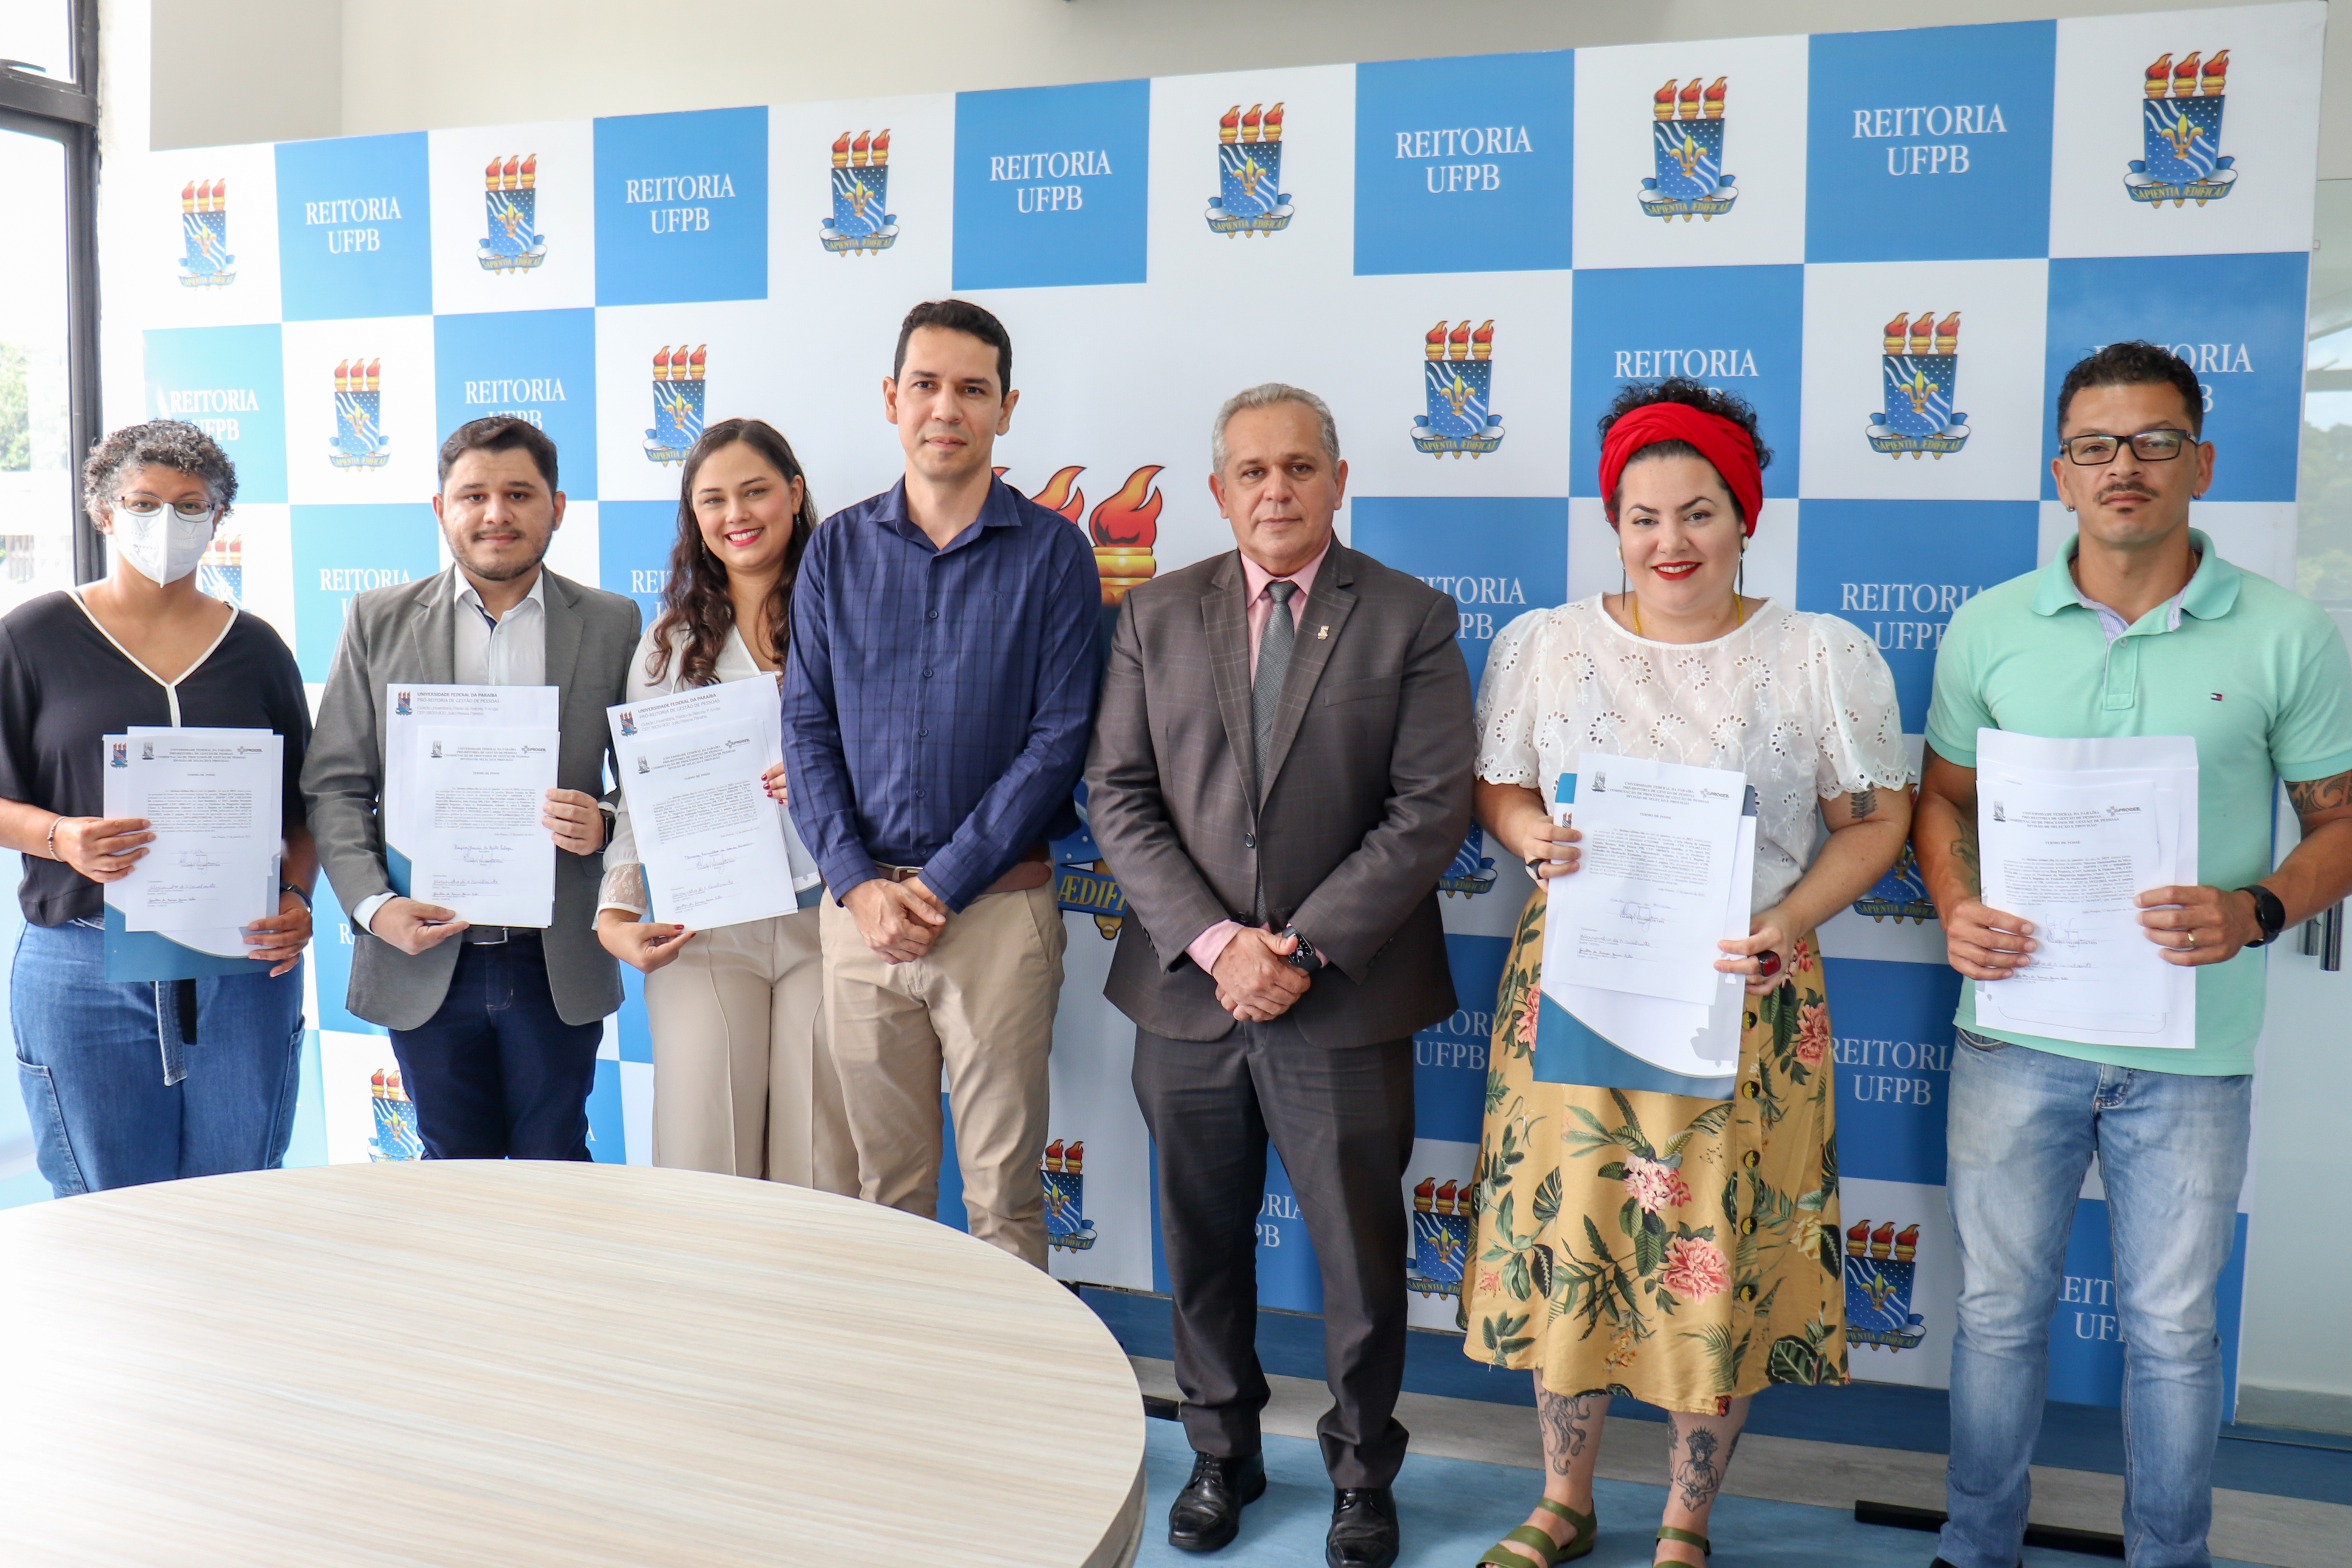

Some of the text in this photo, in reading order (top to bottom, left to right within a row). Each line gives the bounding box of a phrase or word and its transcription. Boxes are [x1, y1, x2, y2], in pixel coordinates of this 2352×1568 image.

[1853, 104, 2007, 138] REITORIA
[1396, 126, 1533, 158] REITORIA
[990, 150, 1112, 181] REITORIA
[1887, 145, 1969, 175] UFPB
[626, 174, 735, 203] REITORIA
[1426, 164, 1500, 193] UFPB
[1018, 186, 1082, 213] UFPB
[2132, 187, 2179, 200] SAPIENTIA
[305, 197, 401, 225] REITORIA
[651, 208, 710, 234] UFPB
[1645, 202, 1688, 214] SAPIENTIA
[1211, 219, 1249, 230] SAPIENTIA
[328, 229, 380, 254] UFPB
[1614, 350, 1759, 378] REITORIA
[171, 389, 259, 412] REITORIA
[465, 378, 566, 404] REITORIA
[1417, 440, 1457, 451] SAPIENTIA
[1873, 437, 1918, 450] SAPIENTIA
[1417, 576, 1526, 605] TORIA
[1840, 583, 1983, 613] REITORI
[1458, 613, 1494, 640] PB
[638, 704, 670, 713] UNIVERSIDADE
[1416, 1041, 1485, 1069] UFPB
[1832, 1038, 1952, 1072] REITORI
[1853, 1074, 1931, 1105] UFPB
[2074, 1311, 2124, 1342] UF
